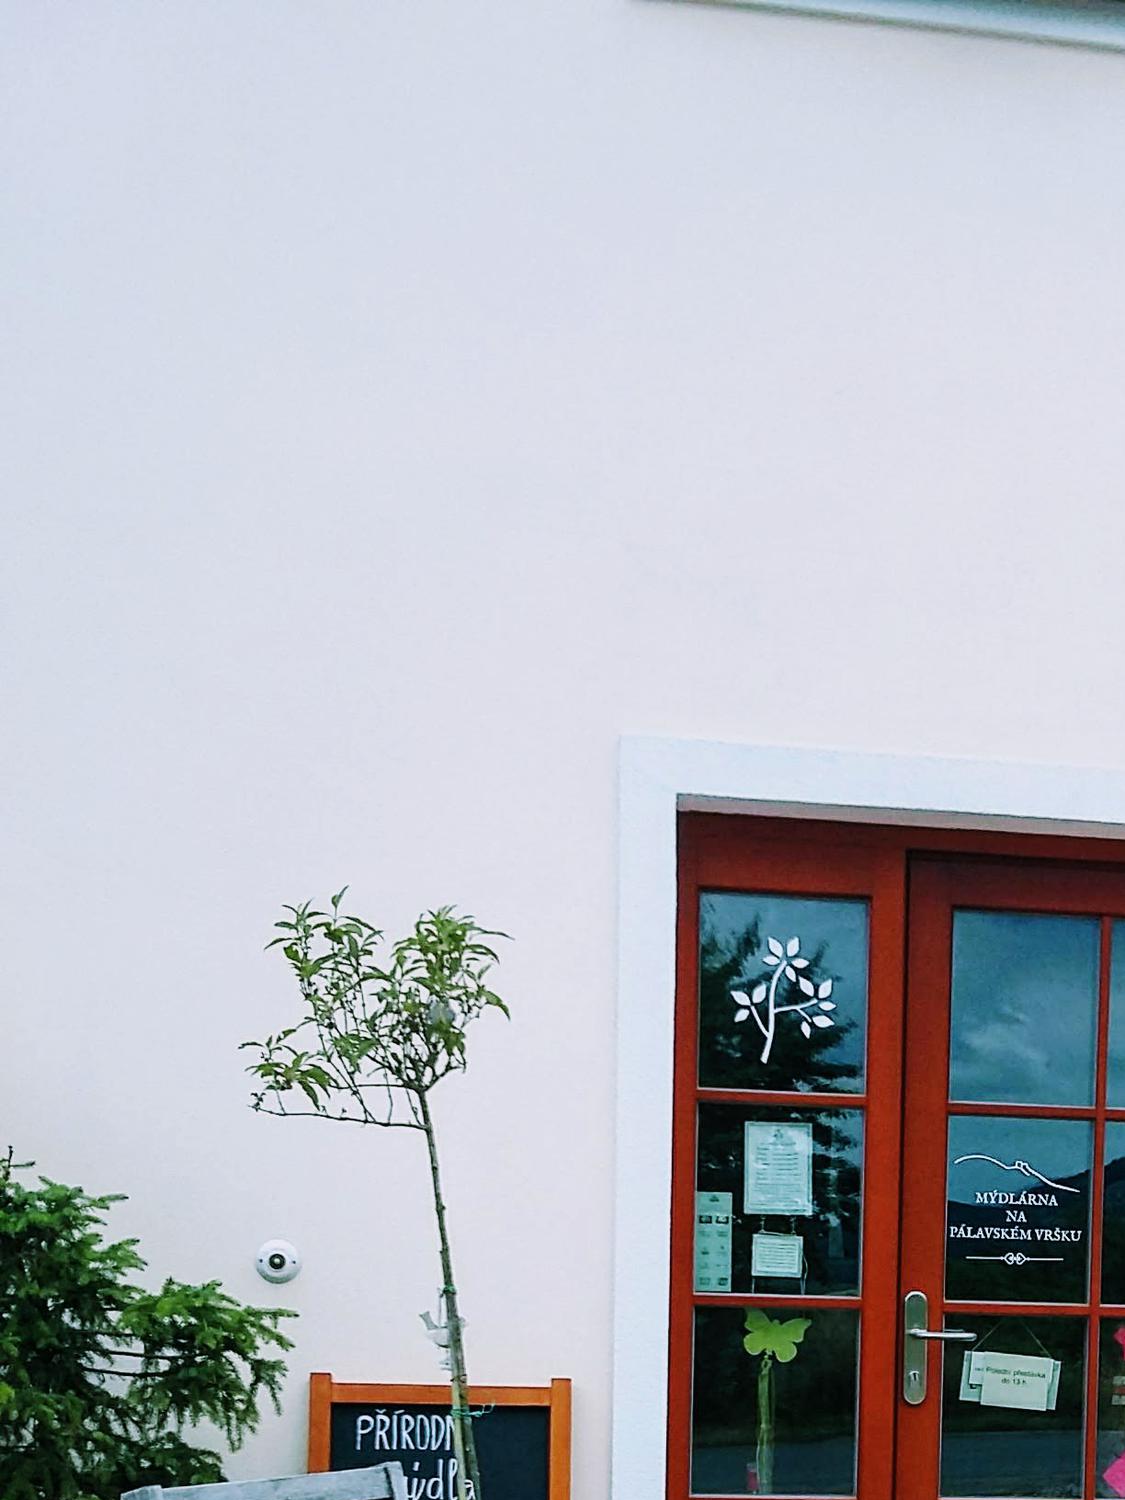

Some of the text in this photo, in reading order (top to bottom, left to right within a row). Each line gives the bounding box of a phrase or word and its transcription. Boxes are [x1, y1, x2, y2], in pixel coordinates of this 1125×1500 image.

[975, 1190, 1058, 1206] MÝDLÁRNA
[1005, 1210, 1027, 1222] NA
[949, 1224, 1082, 1241] PÁLAVSKÉM VRŠKU
[356, 1409, 457, 1451] PŘÍRODN
